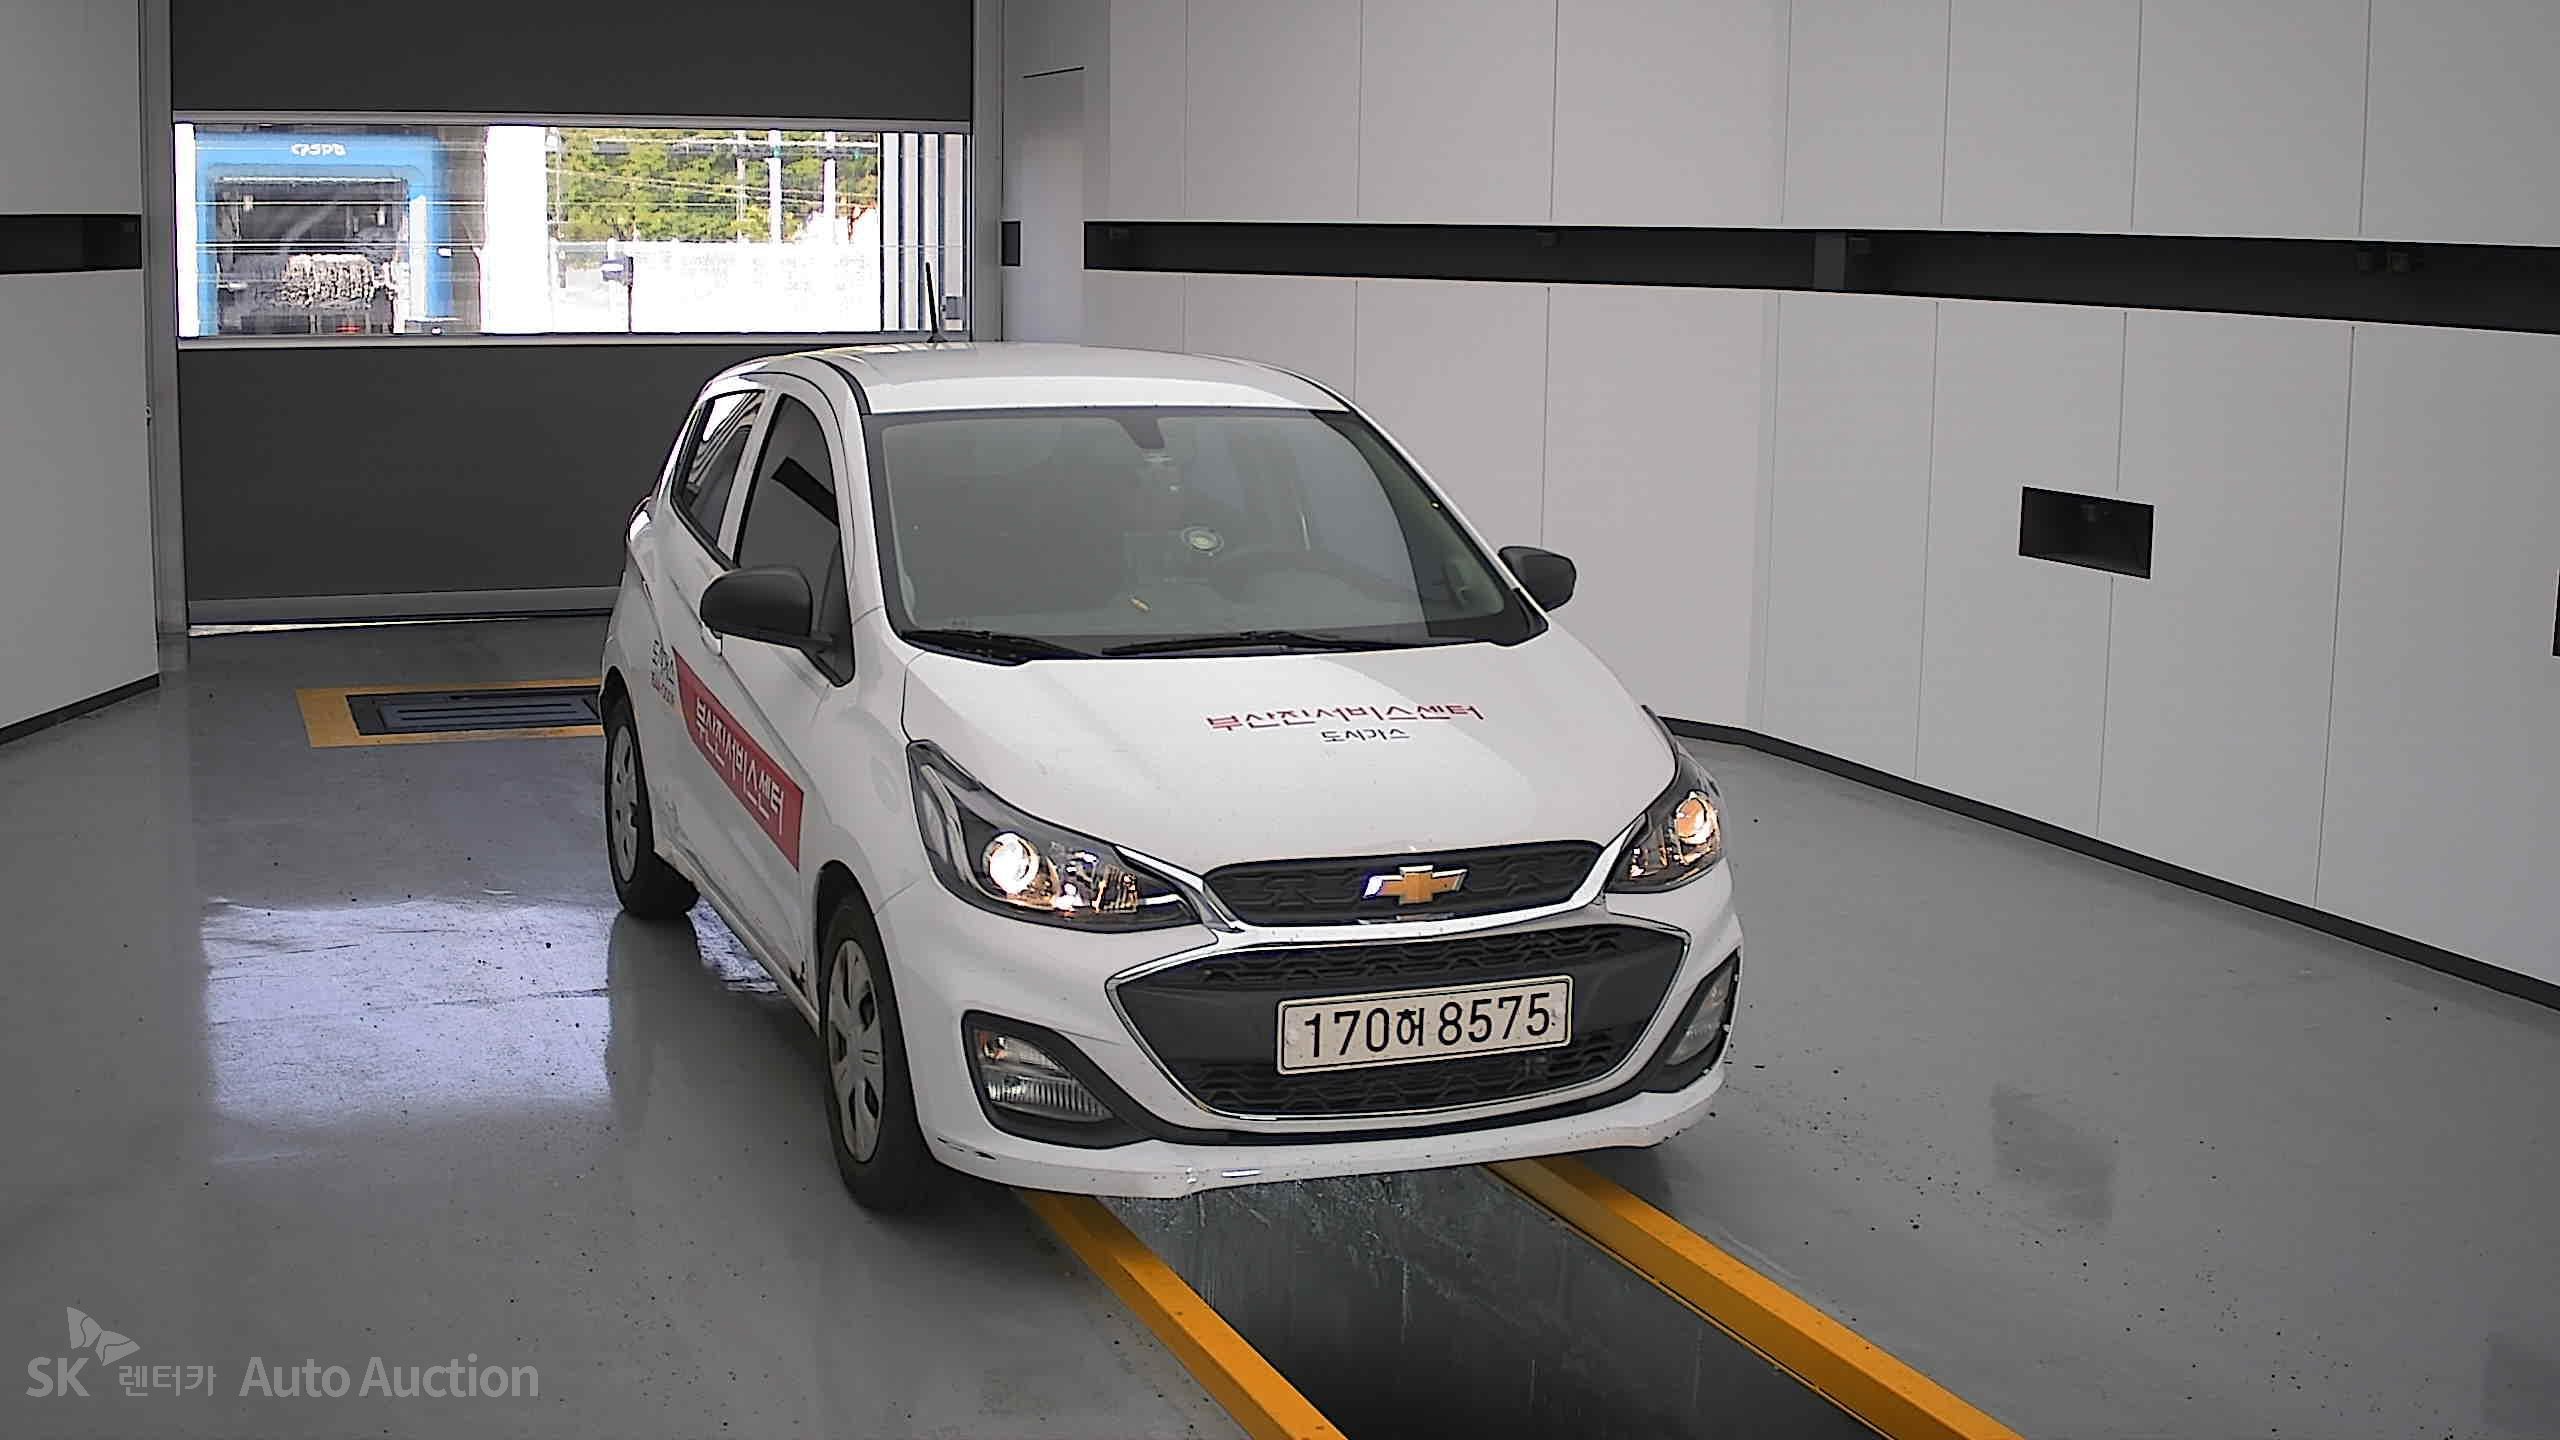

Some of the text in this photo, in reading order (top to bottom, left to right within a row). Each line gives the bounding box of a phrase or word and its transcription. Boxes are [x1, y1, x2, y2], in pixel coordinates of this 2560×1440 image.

[1206, 704, 1485, 732] 부산진서비스센터
[1321, 728, 1411, 743] 도시가스
[696, 697, 785, 836] 부산진서비스센터
[1304, 992, 1552, 1058] 170허 8575
